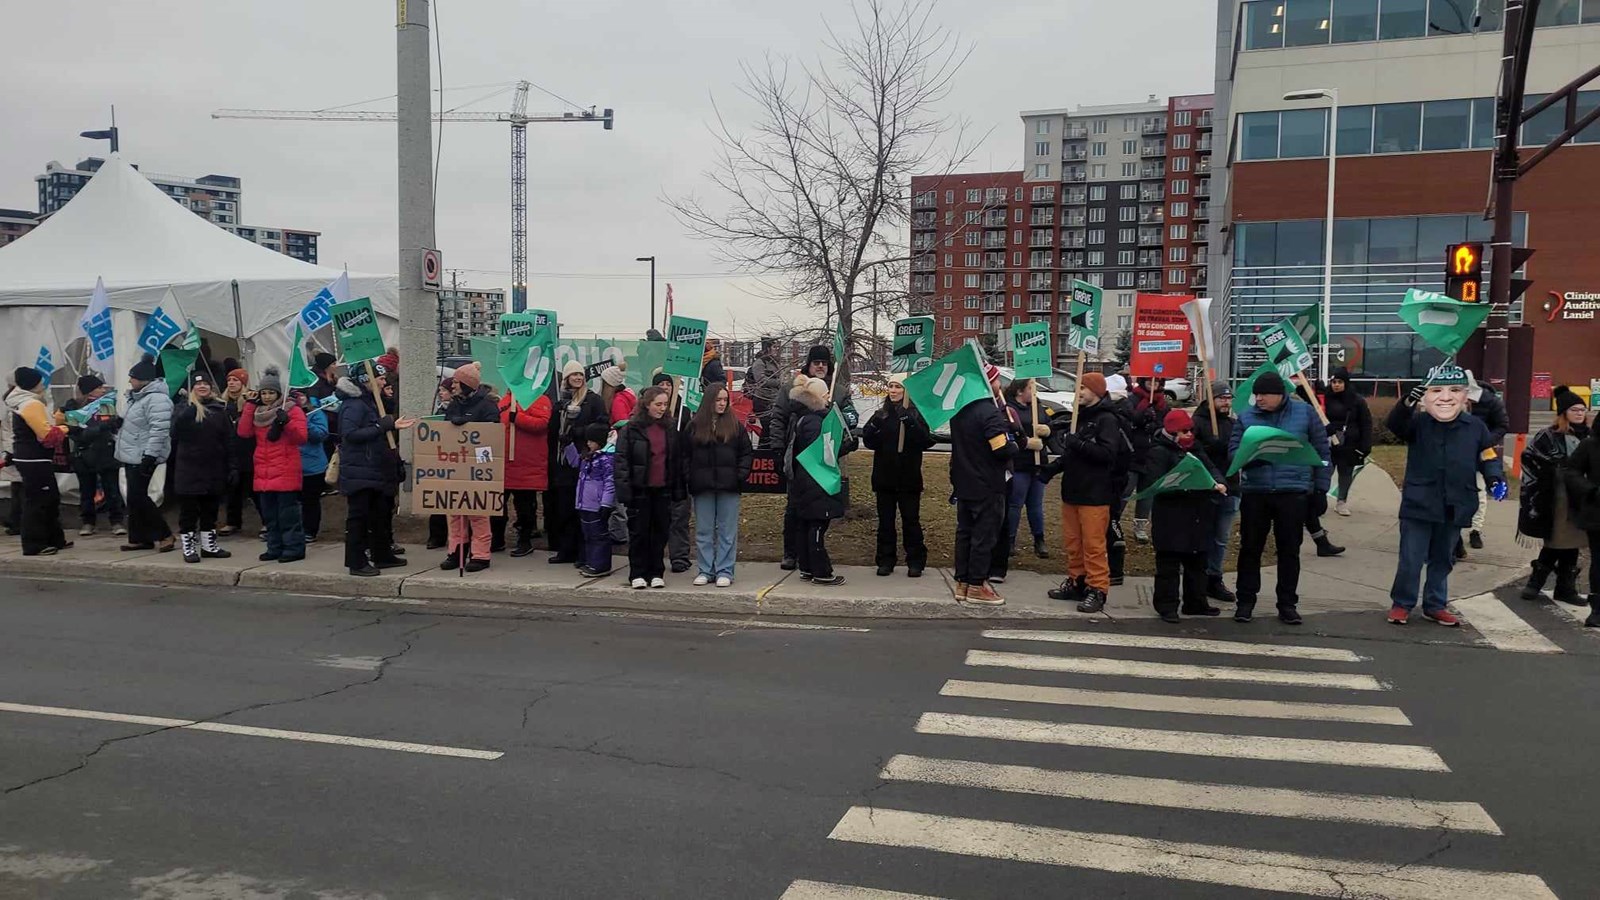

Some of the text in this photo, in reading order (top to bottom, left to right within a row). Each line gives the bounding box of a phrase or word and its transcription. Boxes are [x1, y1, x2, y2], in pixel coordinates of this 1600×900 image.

[1563, 310, 1594, 319] Laniel
[898, 323, 922, 335] GRÈVE
[417, 422, 481, 444] On se
[437, 446, 469, 463] bat
[752, 458, 775, 470] DES
[416, 466, 493, 485] pour les
[422, 490, 504, 511] ENFANTS
